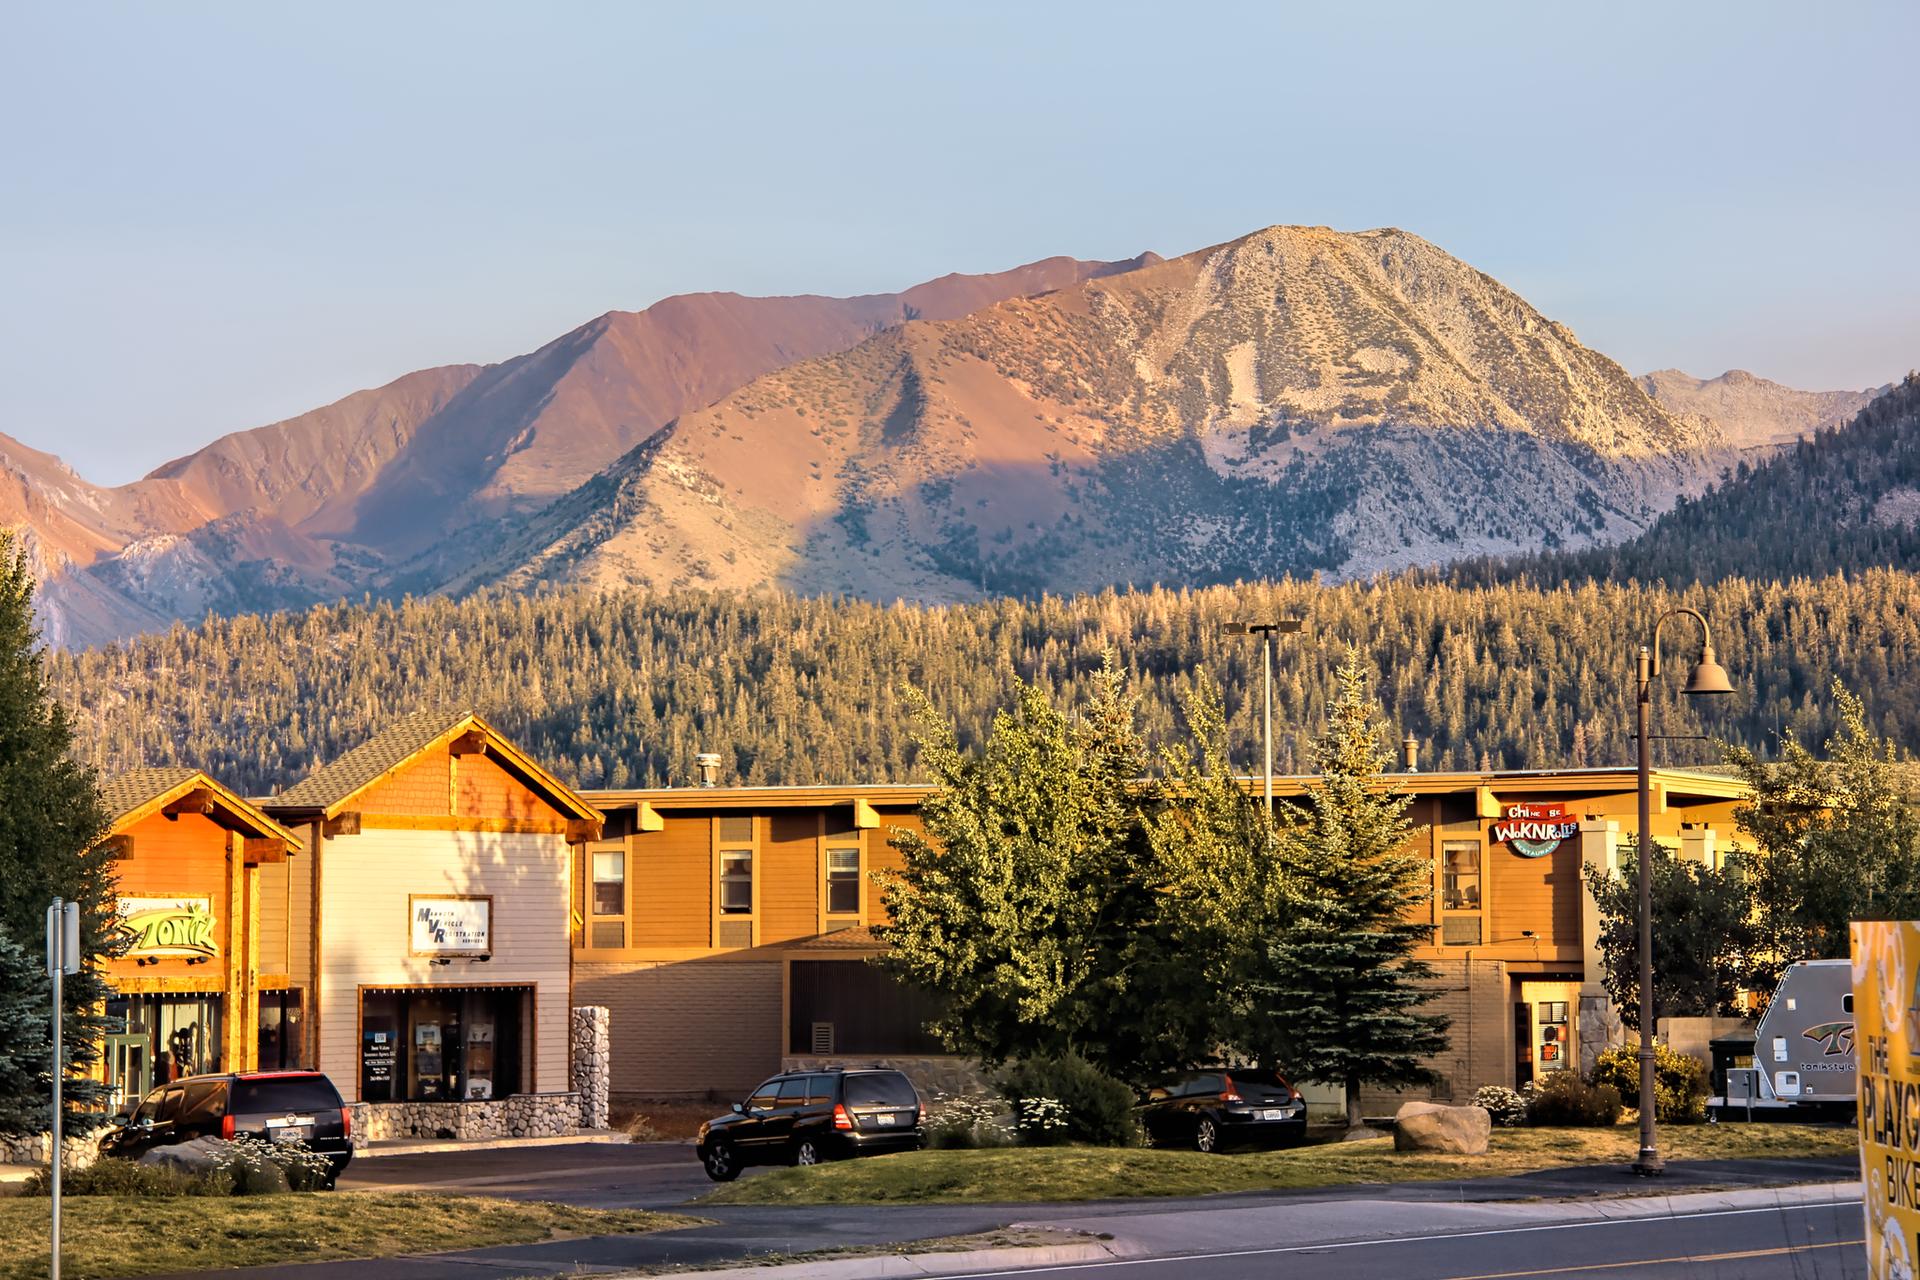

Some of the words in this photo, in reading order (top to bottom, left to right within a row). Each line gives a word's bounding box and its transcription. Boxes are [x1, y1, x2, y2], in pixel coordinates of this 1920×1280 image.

[1868, 1035, 1889, 1075] THE
[1861, 1074, 1920, 1151] PLAYG
[1886, 1155, 1920, 1210] BIKE
